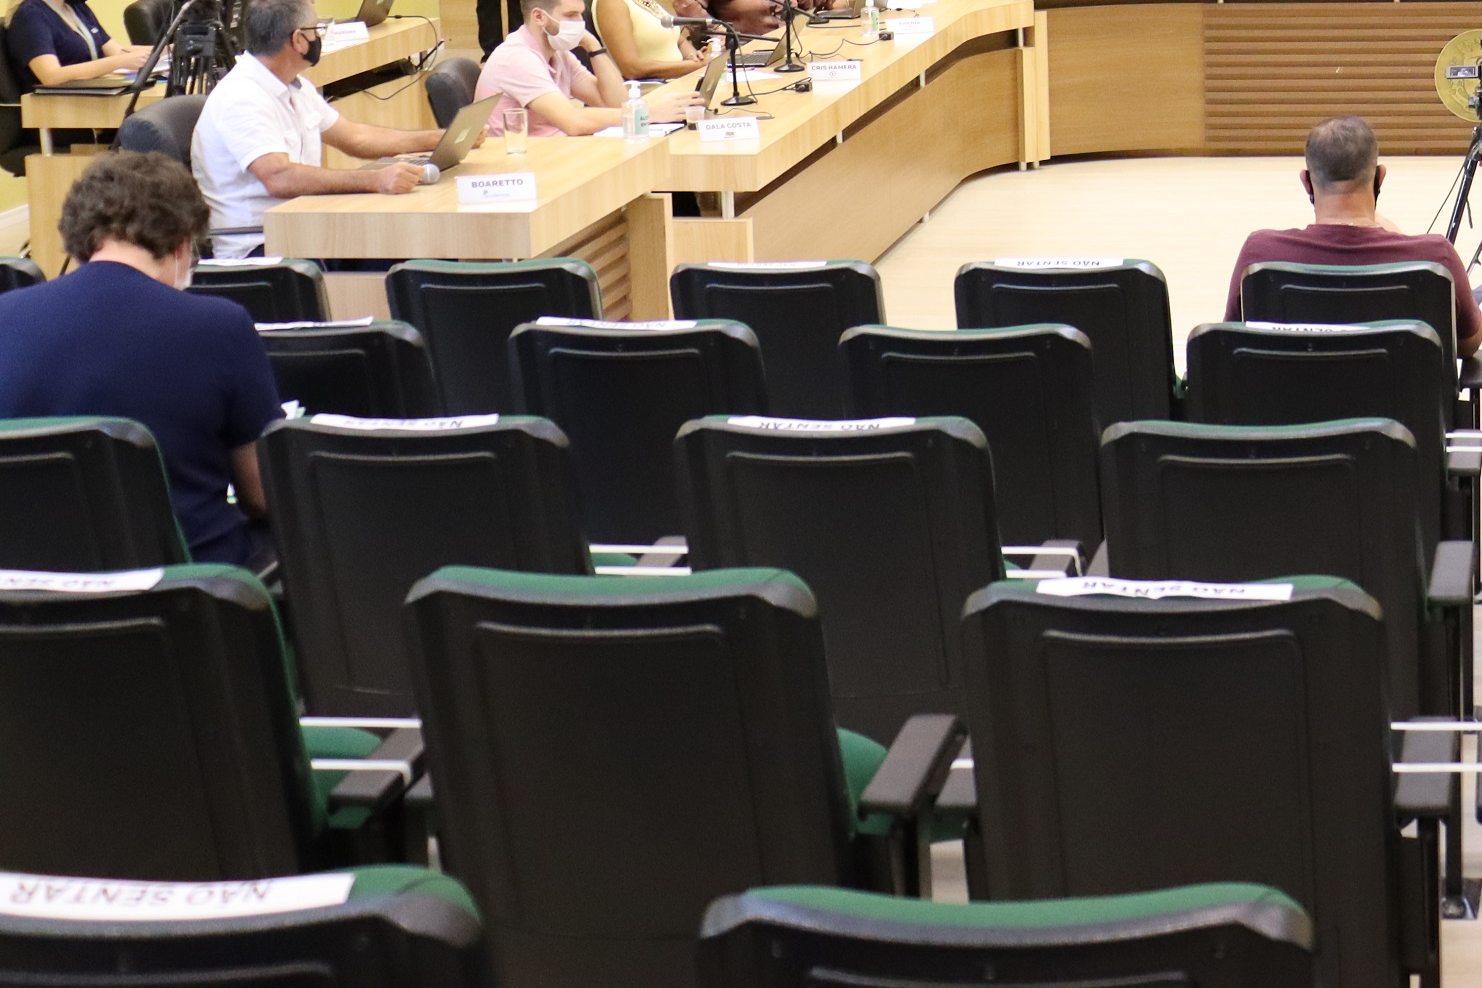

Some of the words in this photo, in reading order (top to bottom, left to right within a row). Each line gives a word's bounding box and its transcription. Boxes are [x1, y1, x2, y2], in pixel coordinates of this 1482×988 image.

[471, 178, 524, 188] BOARETTO
[760, 422, 832, 430] SENTAR
[1082, 582, 1181, 596] SENTAR
[10, 878, 172, 905] SENTAR
[186, 879, 276, 905] NÃO
